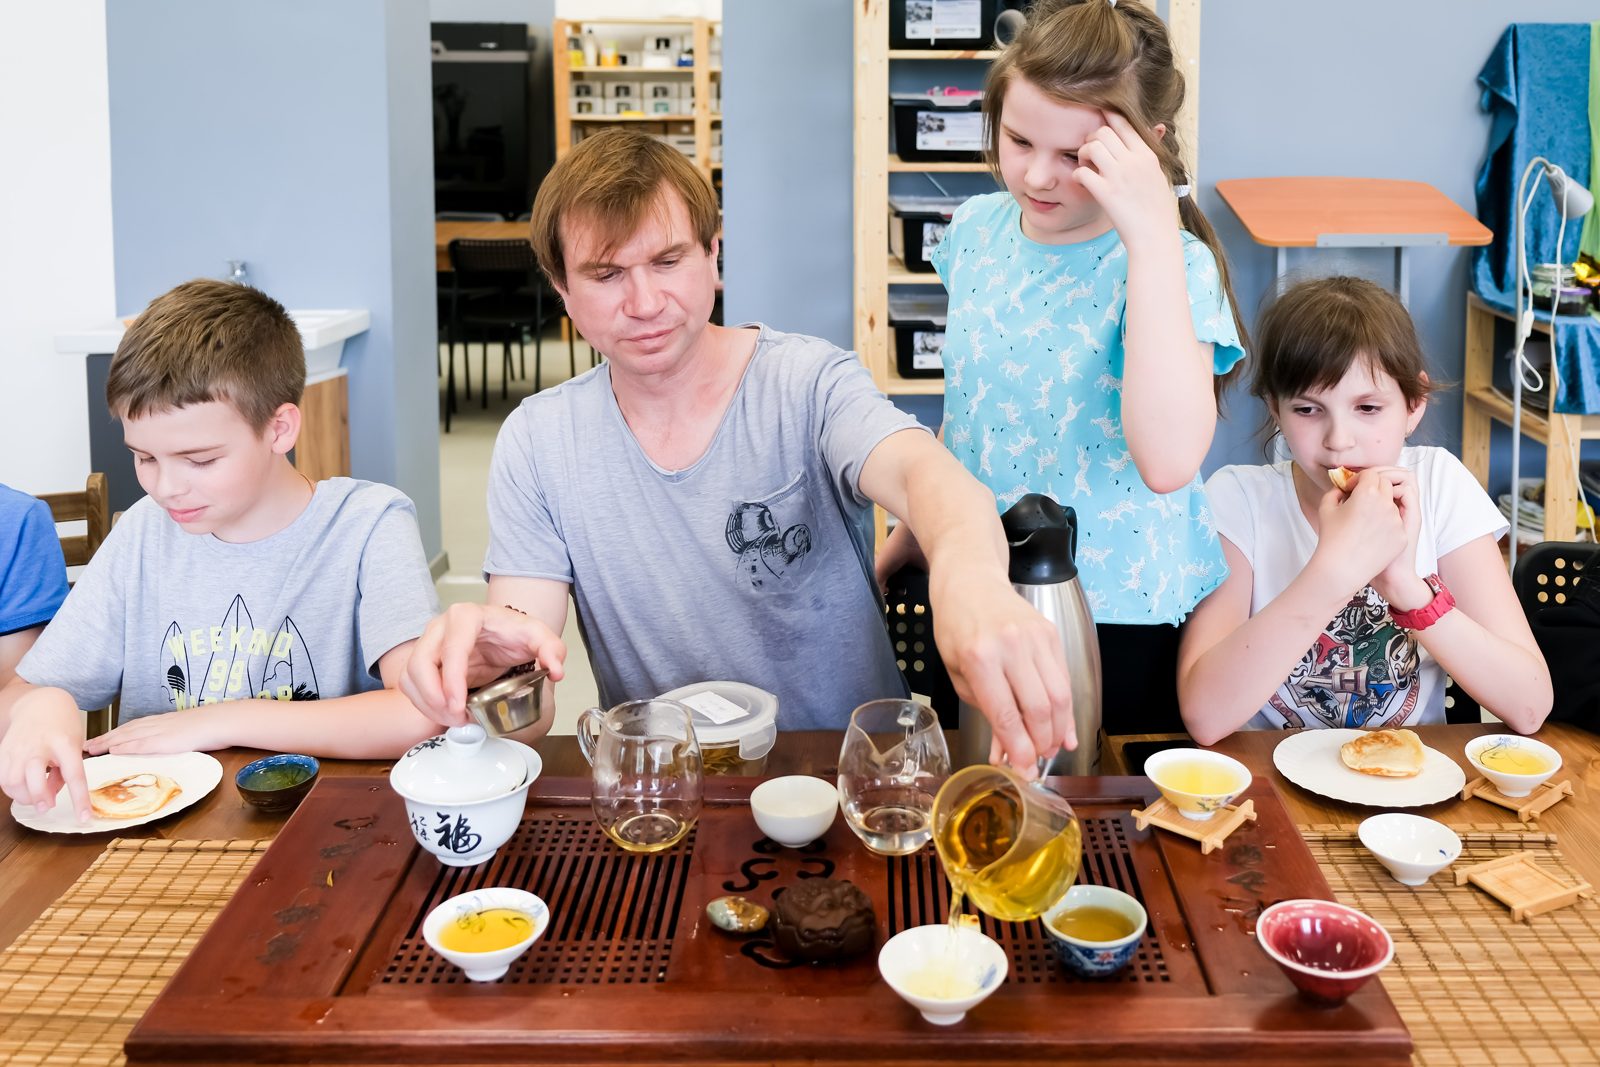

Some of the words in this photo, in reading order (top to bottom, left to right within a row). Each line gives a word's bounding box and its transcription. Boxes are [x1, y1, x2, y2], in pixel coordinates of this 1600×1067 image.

[208, 659, 245, 692] 99
[1340, 669, 1362, 692] H
[434, 811, 482, 854] 福
